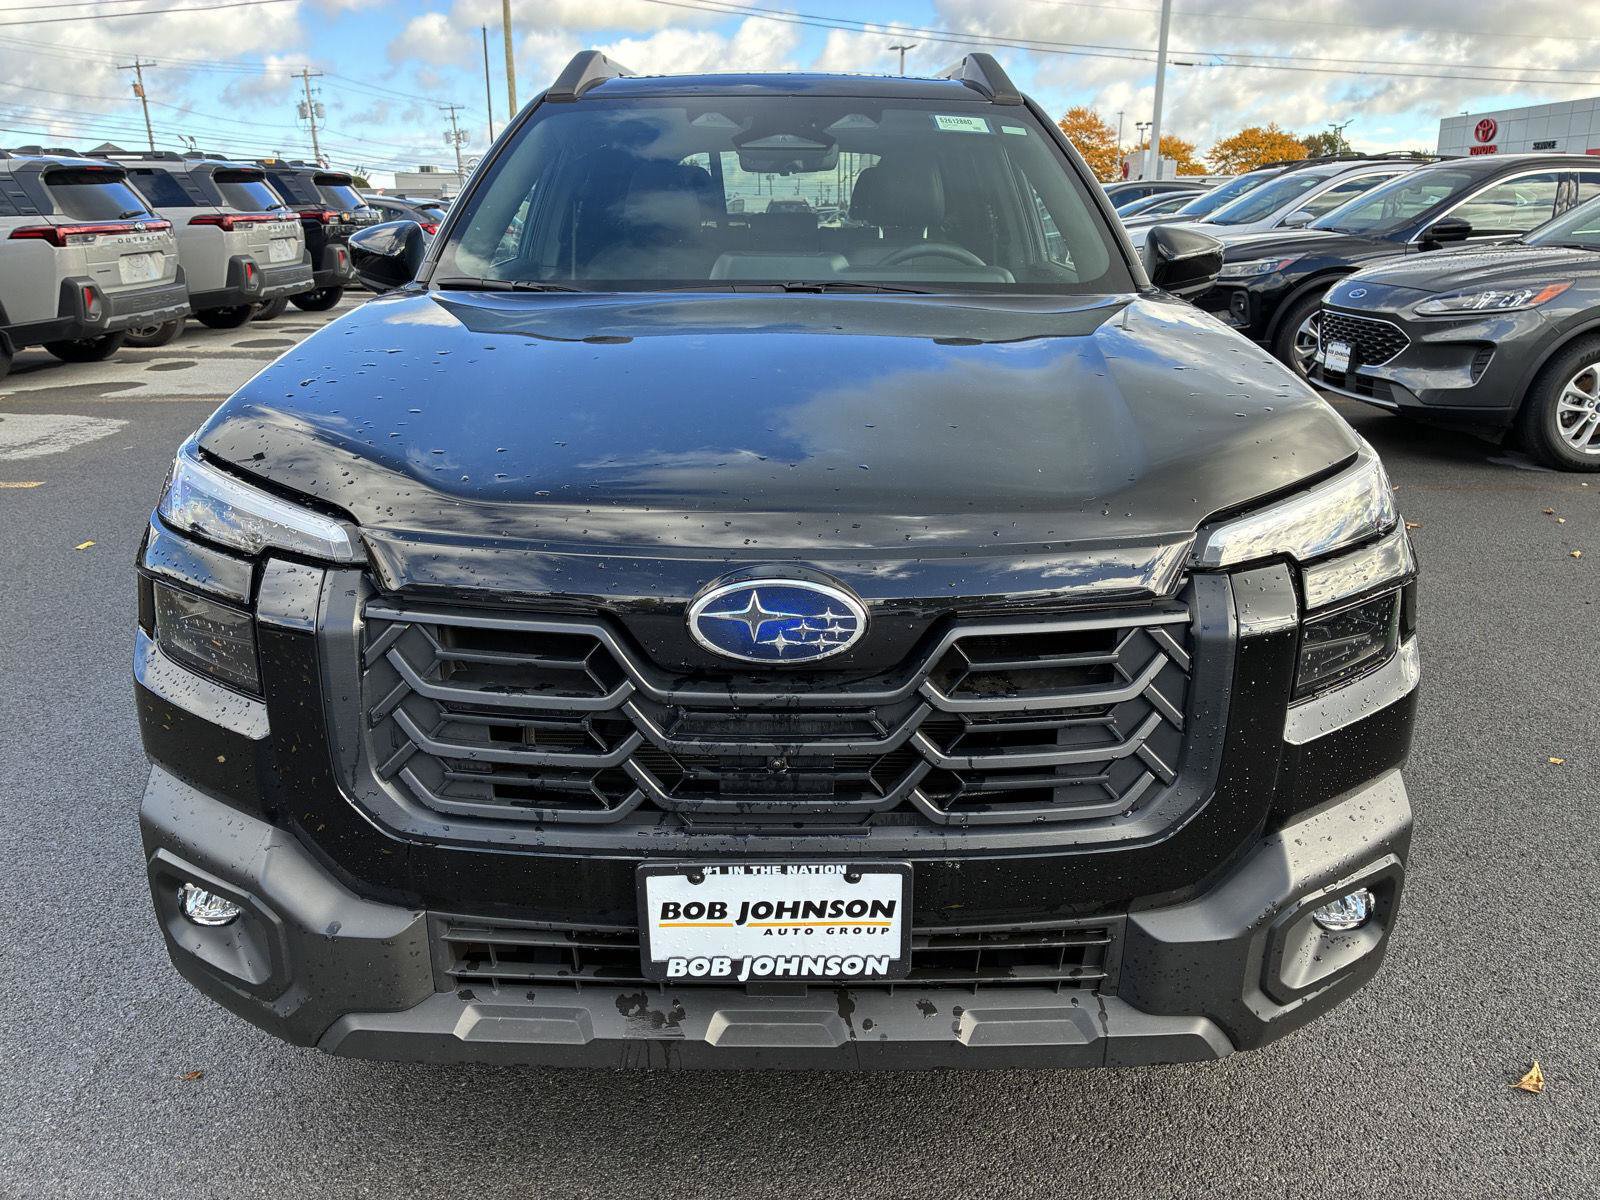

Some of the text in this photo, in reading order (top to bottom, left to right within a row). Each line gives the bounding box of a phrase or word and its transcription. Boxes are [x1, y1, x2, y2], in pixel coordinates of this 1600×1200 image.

[1469, 144, 1498, 156] TOYOTA
[117, 235, 161, 244] OUTBACK
[702, 865, 847, 875] #1 IN THE NATION
[660, 899, 897, 926] BOB JOHNSON
[763, 926, 890, 936] AUTO GROUP
[666, 955, 890, 982] BOB JOHNSON
